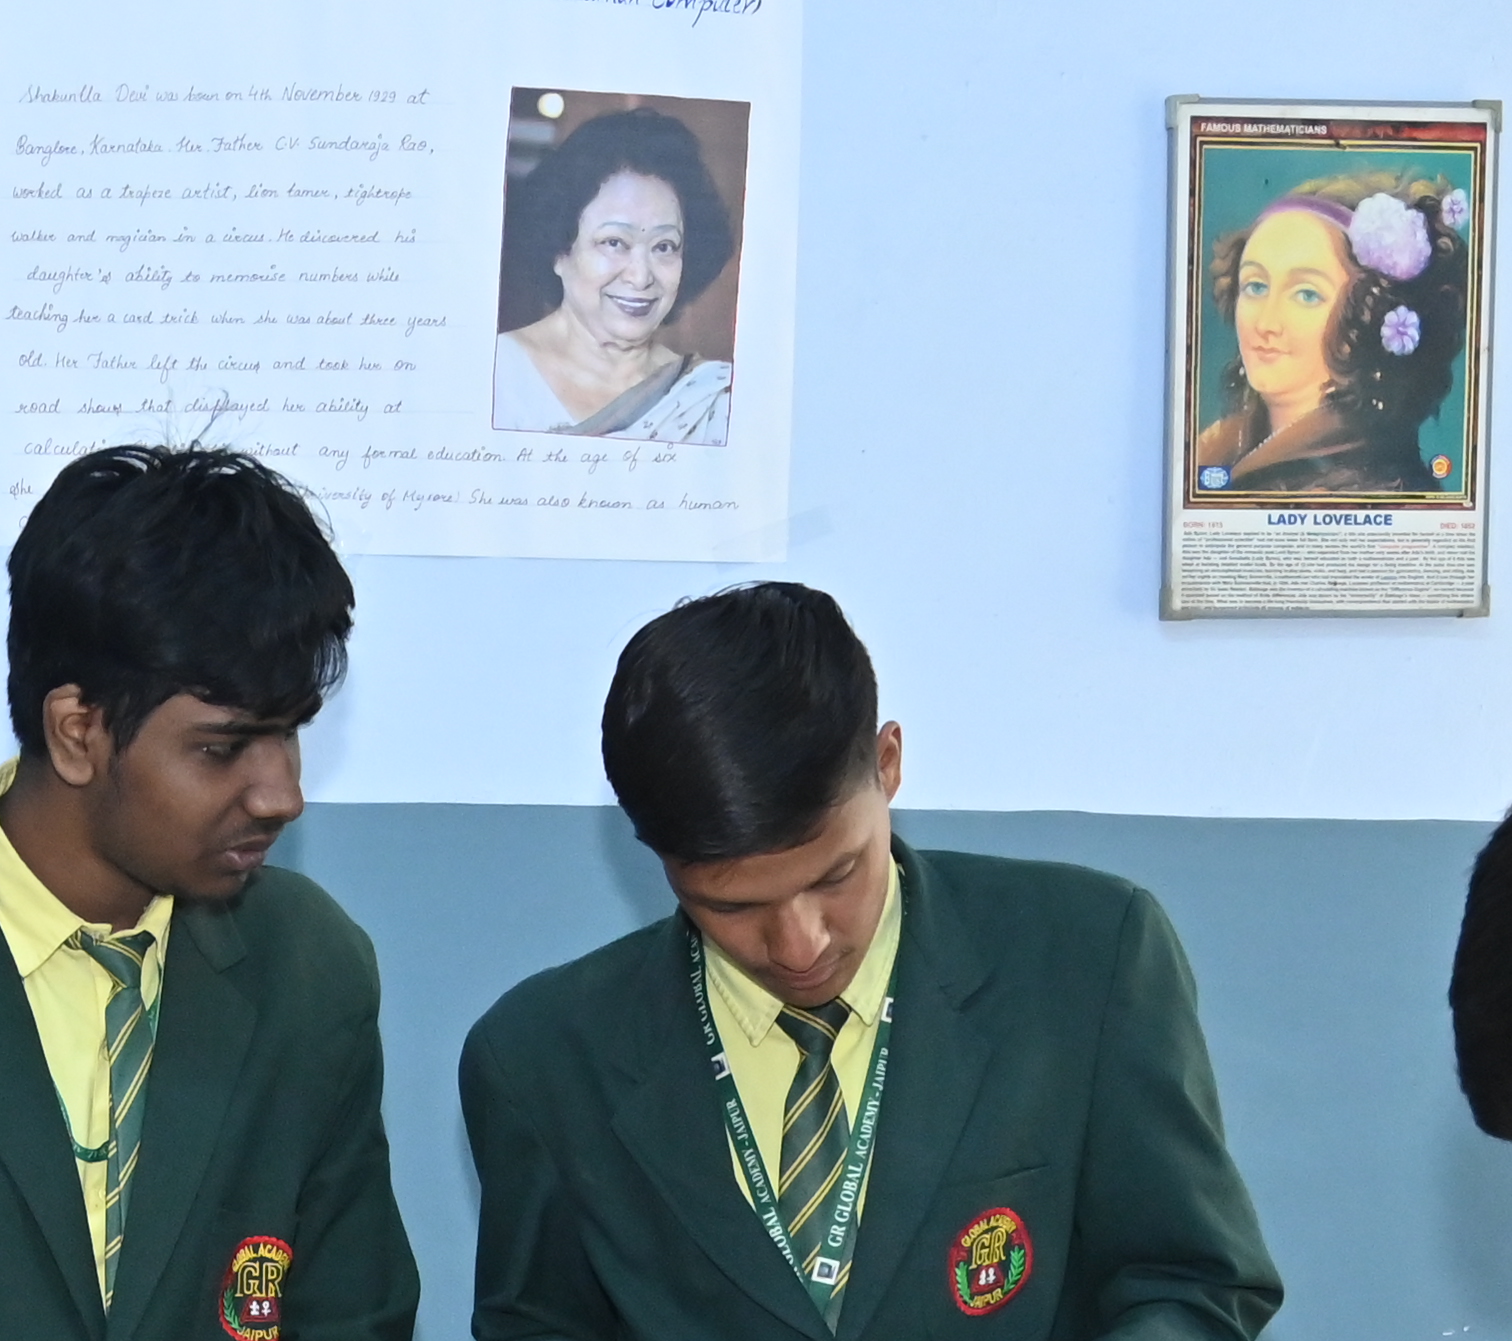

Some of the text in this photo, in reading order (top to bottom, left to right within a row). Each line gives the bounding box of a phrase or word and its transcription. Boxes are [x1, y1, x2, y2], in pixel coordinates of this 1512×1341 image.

[115, 83, 149, 102] Devi
[156, 90, 178, 102] was
[225, 90, 243, 101] on
[281, 82, 362, 102] November
[368, 89, 396, 103] 1929
[406, 88, 430, 105] at
[211, 133, 263, 152] Father
[1201, 123, 1327, 135] FAMOUS MATHEMATICIANS
[12, 181, 63, 199] worked
[76, 186, 93, 199] as
[100, 187, 113, 199] a
[244, 182, 279, 199] lion
[343, 183, 412, 207] tightrope
[66, 230, 96, 243] and
[172, 226, 196, 243] in
[205, 234, 217, 244] a
[277, 228, 294, 243] He
[394, 228, 416, 244] his
[125, 263, 173, 291] ability
[180, 270, 201, 282] to
[298, 266, 359, 282] numbers
[107, 313, 116, 324] a
[123, 310, 154, 324] card
[286, 313, 311, 325] was
[316, 310, 353, 325] about
[405, 316, 447, 337] years
[1267, 513, 1393, 526] LADY LOVELACE
[726, 1097, 749, 1140] JAIPUR
[855, 1098, 880, 1159] ACADEMY
[742, 1149, 770, 1203] ACADEMY
[834, 1162, 863, 1222] GLOBAL
[828, 1224, 846, 1247] GR
[969, 1227, 1006, 1270] GR
[234, 1261, 283, 1297] GR
